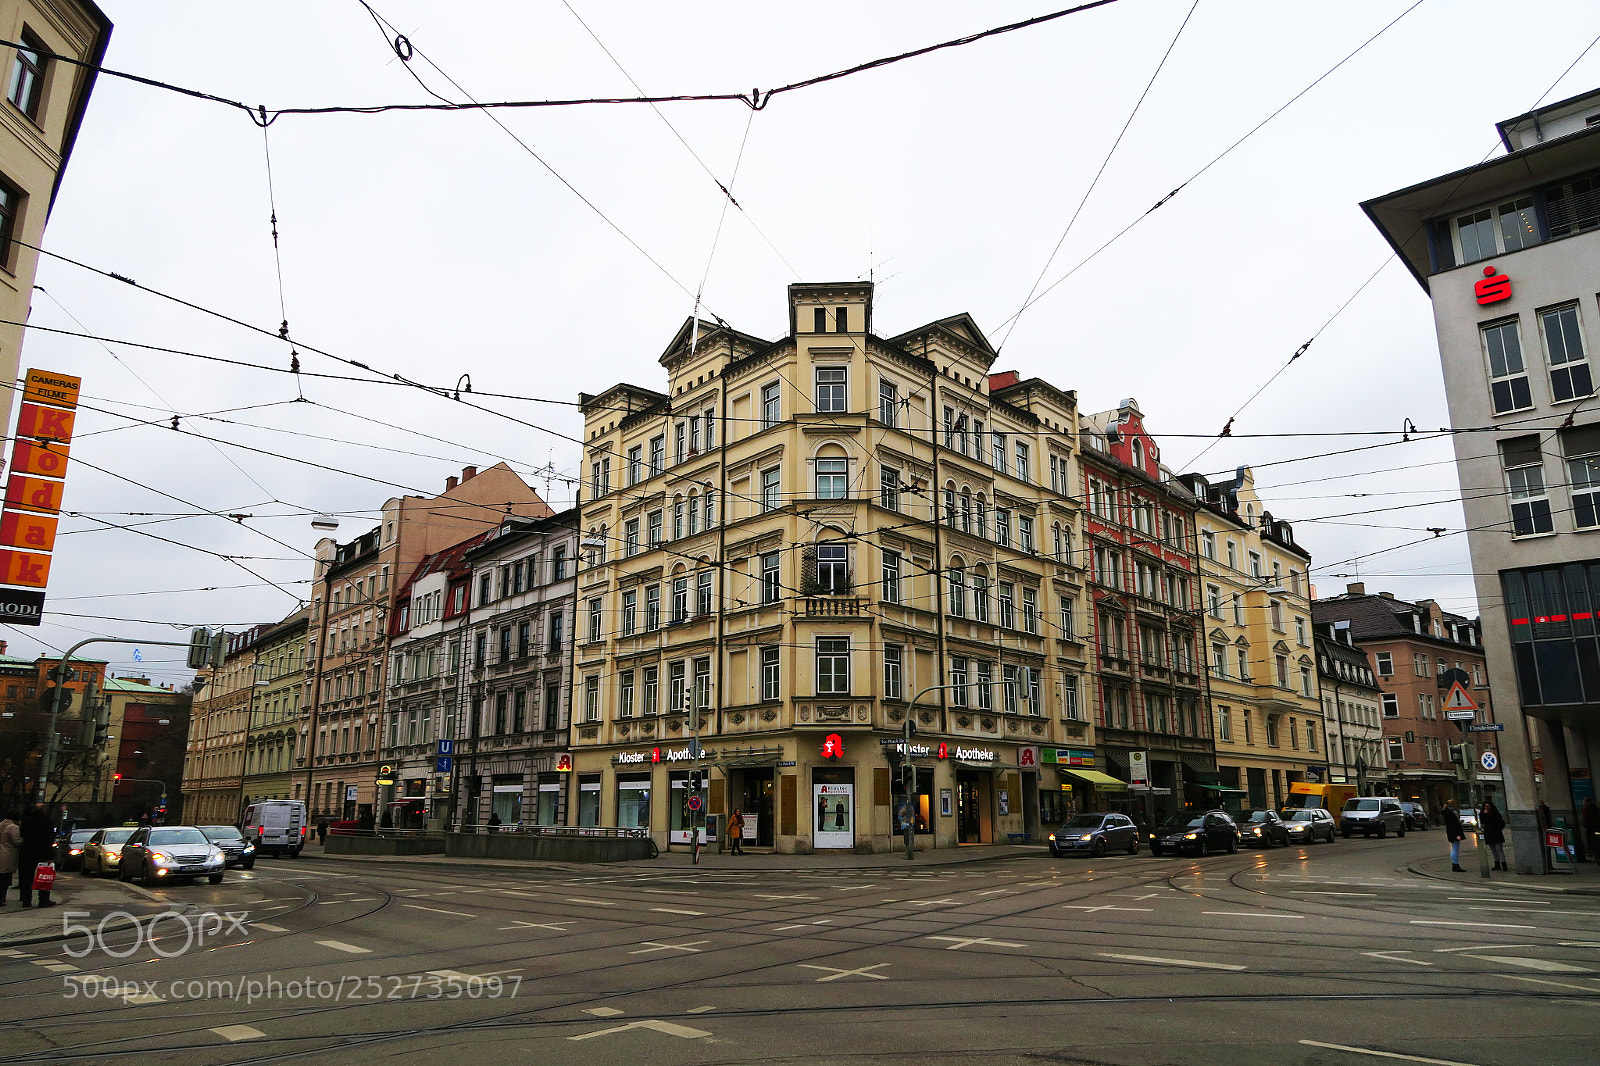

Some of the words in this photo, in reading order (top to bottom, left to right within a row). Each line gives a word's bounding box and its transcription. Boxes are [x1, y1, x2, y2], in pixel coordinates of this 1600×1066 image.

[31, 375, 79, 390] CAMERAS
[38, 387, 67, 400] FILME
[15, 408, 71, 584] Kodak
[441, 741, 450, 753] U
[955, 745, 994, 761] Apotheke
[619, 751, 645, 764] Kloster
[666, 747, 706, 764] Apothe
